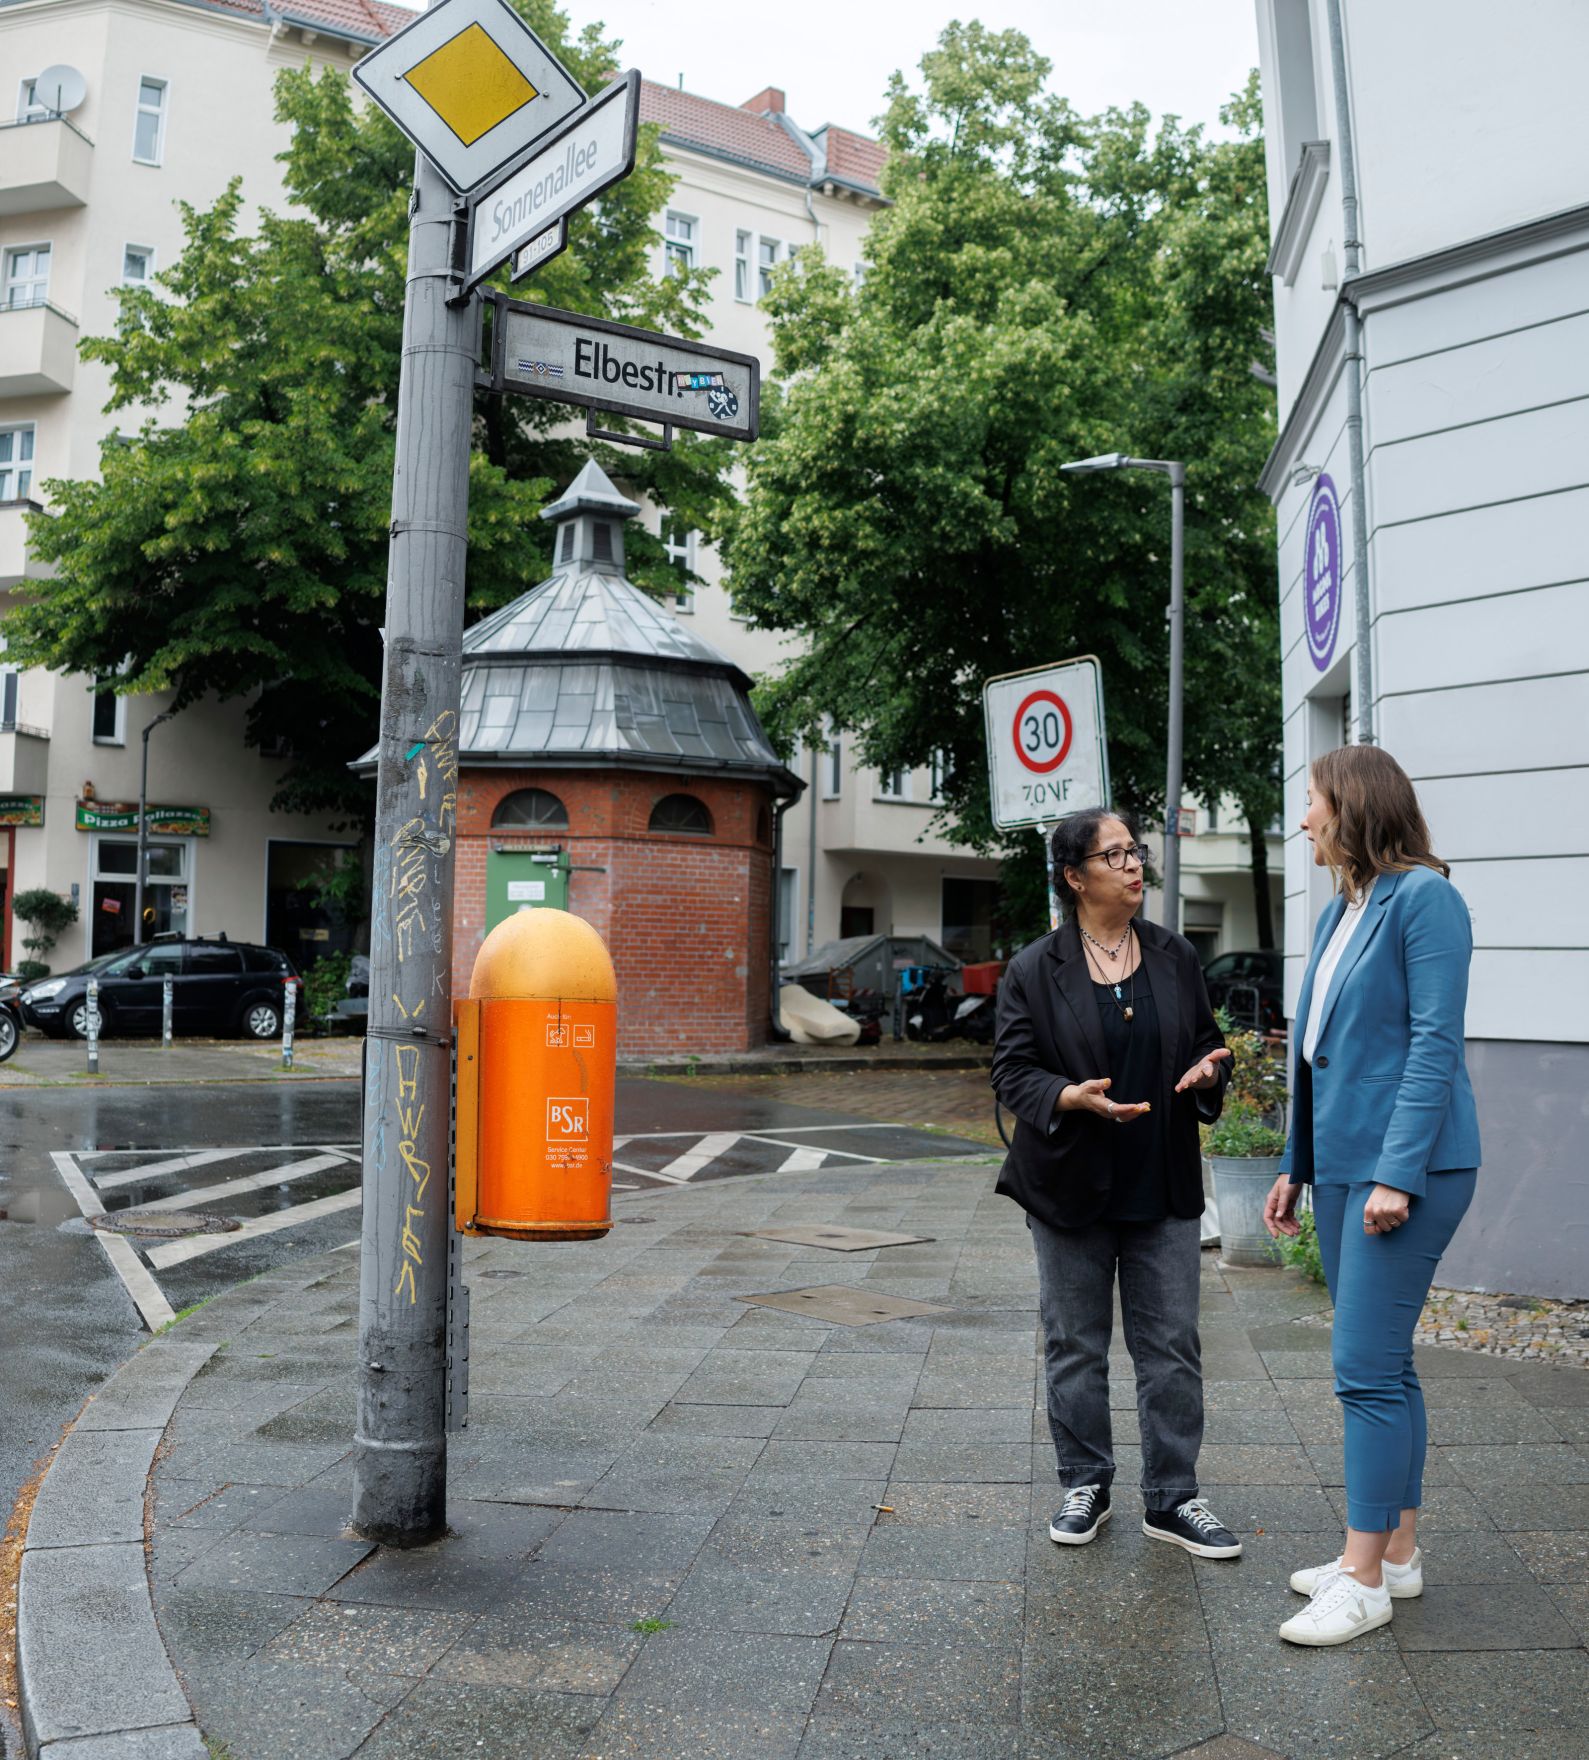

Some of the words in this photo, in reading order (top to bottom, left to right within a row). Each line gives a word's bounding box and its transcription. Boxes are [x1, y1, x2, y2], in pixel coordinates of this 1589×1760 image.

[492, 140, 597, 243] Sonnenallee
[522, 232, 554, 264] 91-105
[575, 337, 683, 398] Elbestr.
[1024, 712, 1060, 752] 30
[84, 813, 128, 827] Pizza
[551, 1105, 584, 1133] BSR
